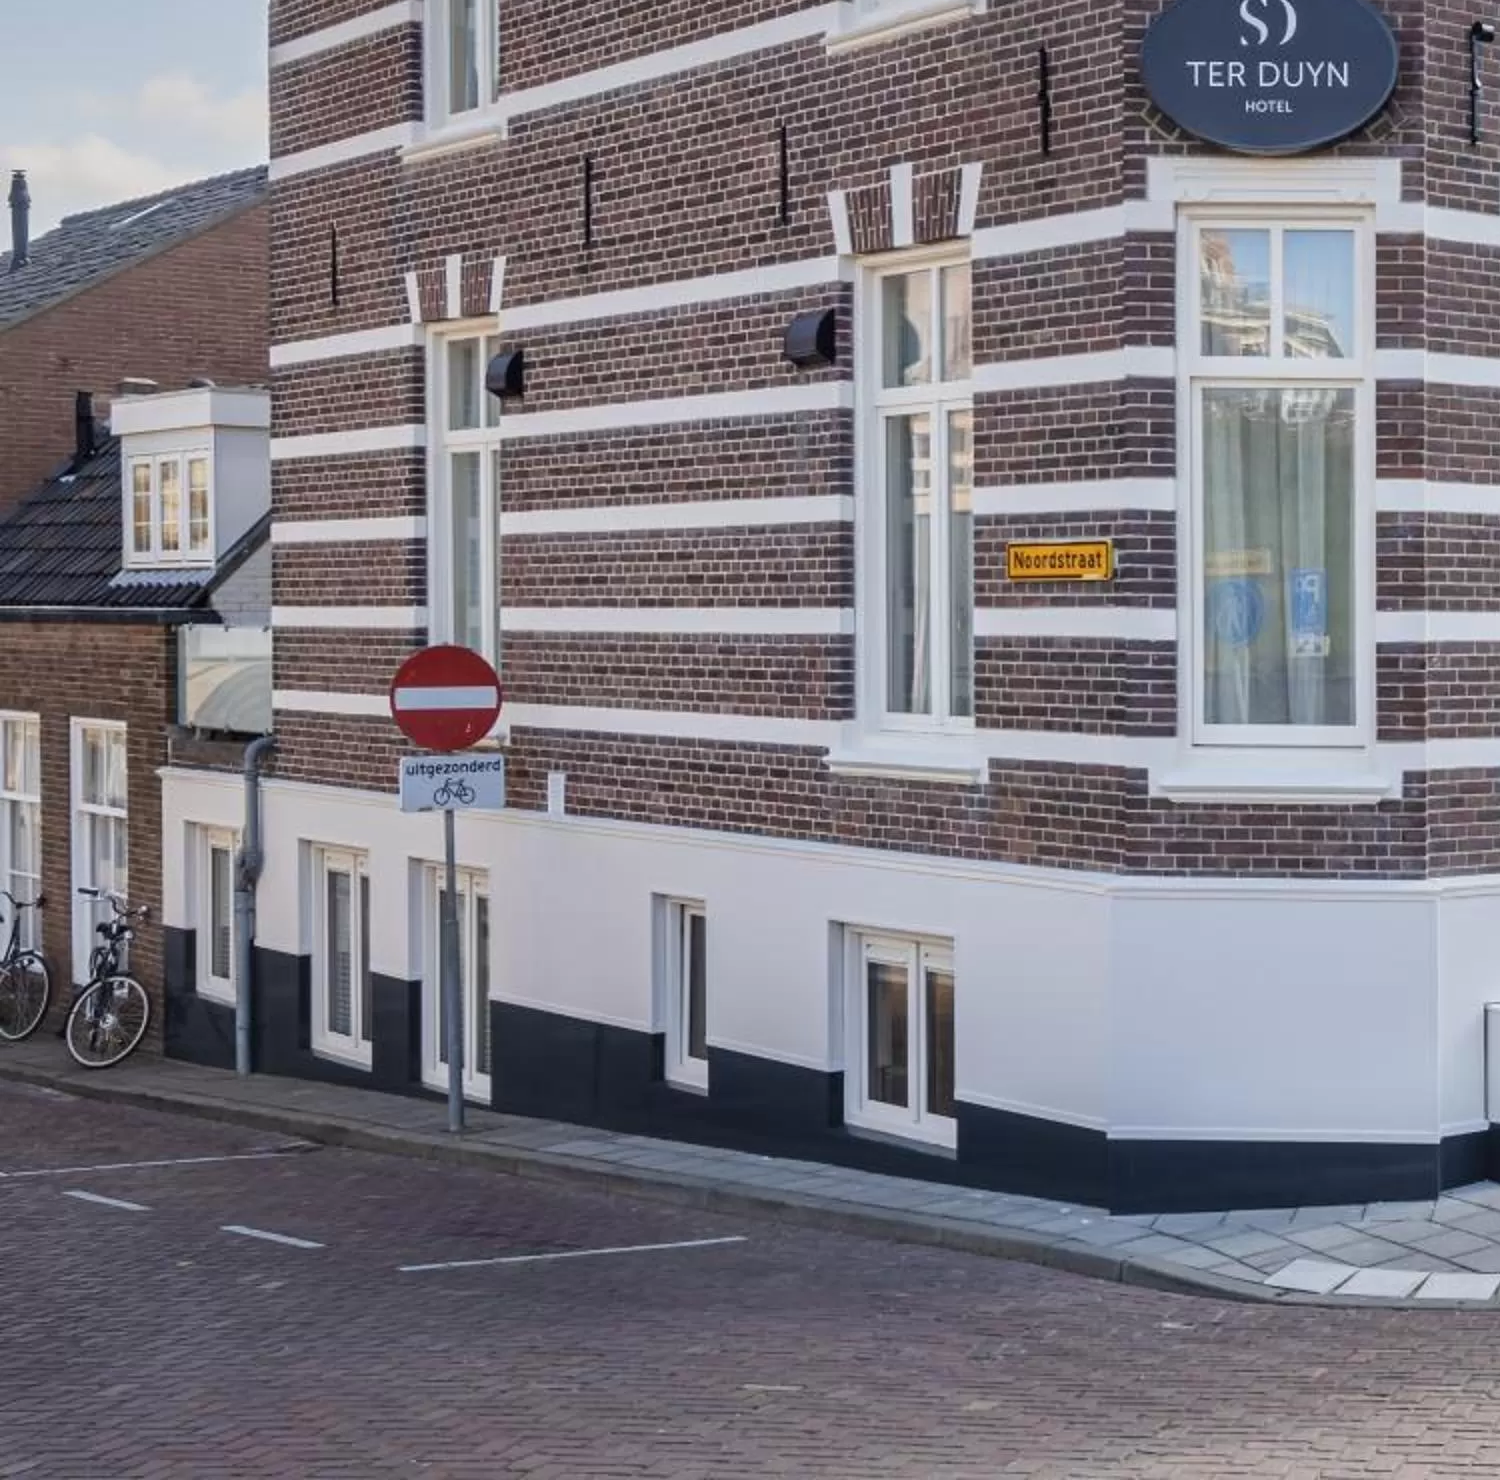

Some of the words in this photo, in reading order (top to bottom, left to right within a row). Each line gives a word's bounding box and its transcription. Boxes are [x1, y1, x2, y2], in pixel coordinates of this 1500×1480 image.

[1185, 60, 1247, 88] TER
[1258, 60, 1350, 88] DUYN
[1244, 99, 1293, 114] HOTEL
[1012, 550, 1102, 569] Noordstraat
[404, 758, 502, 779] uitgezonderd
